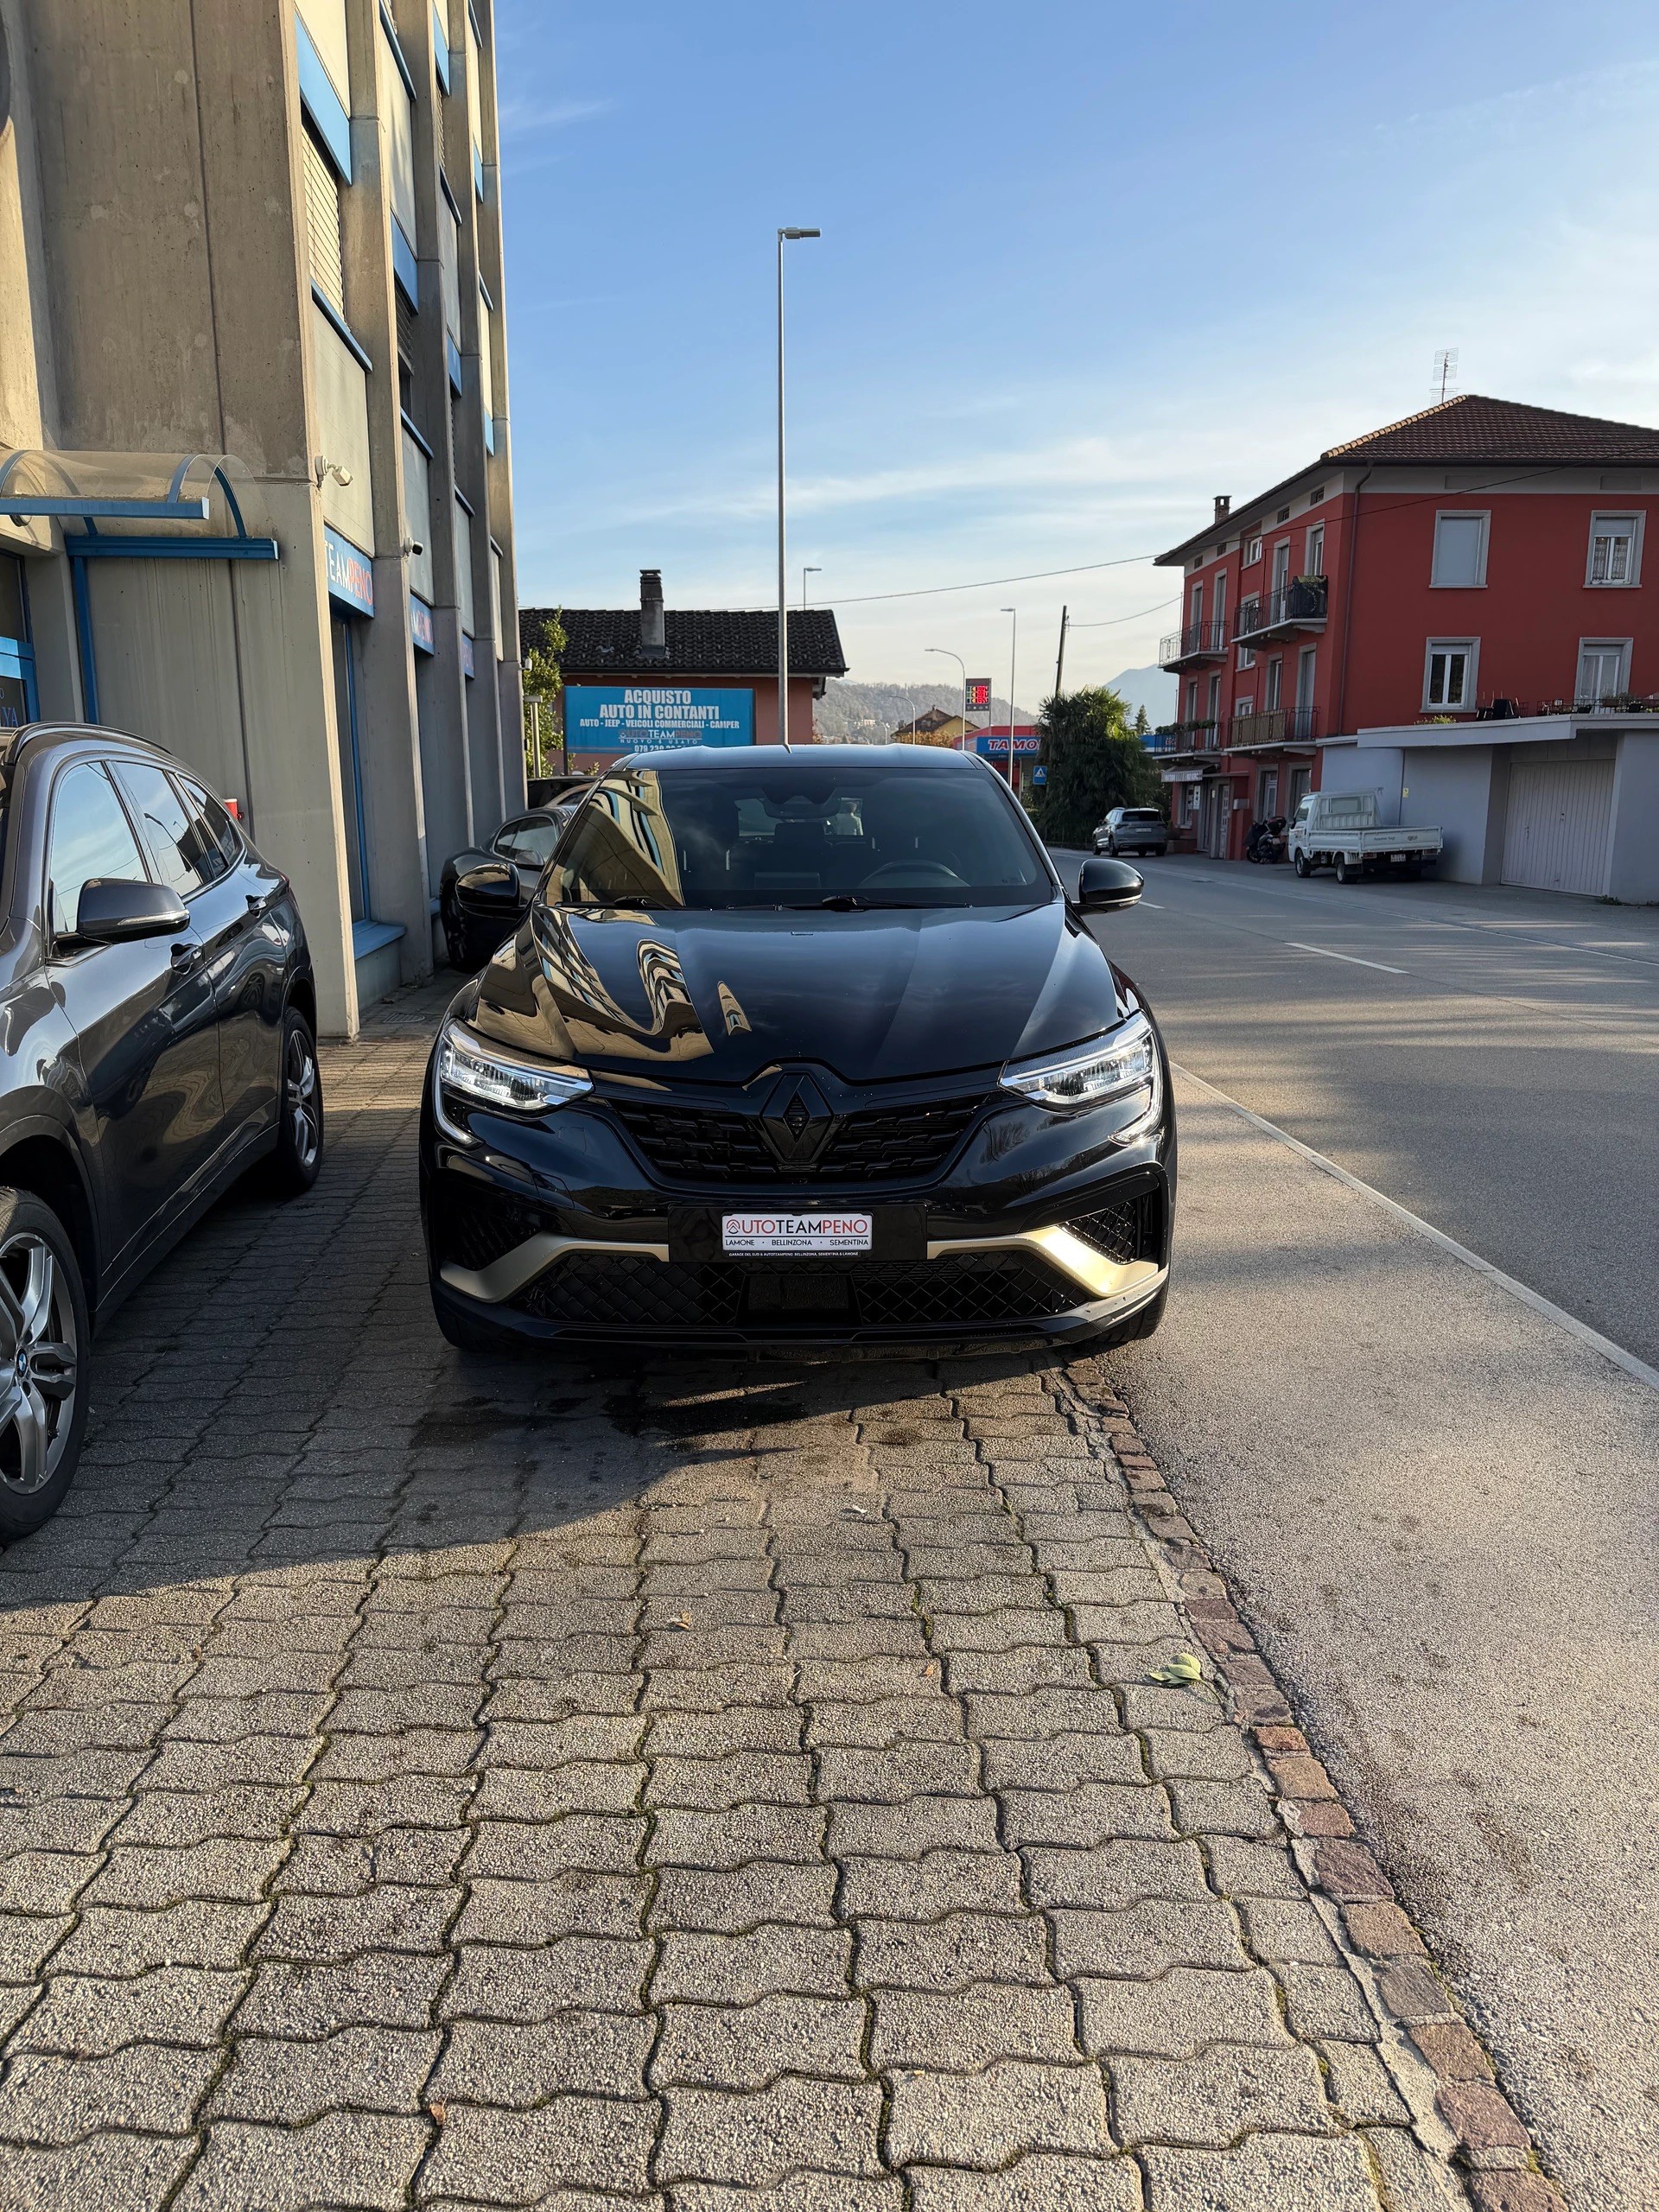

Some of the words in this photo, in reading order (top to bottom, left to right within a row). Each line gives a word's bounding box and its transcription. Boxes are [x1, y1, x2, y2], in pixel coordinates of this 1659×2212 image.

[624, 690, 691, 704] ACQUISTO
[599, 705, 635, 719] AUTO
[638, 705, 652, 719] IN
[654, 705, 720, 720] CONTANTI
[580, 718, 599, 727] AUTO
[654, 720, 704, 728] COMMERCIALI
